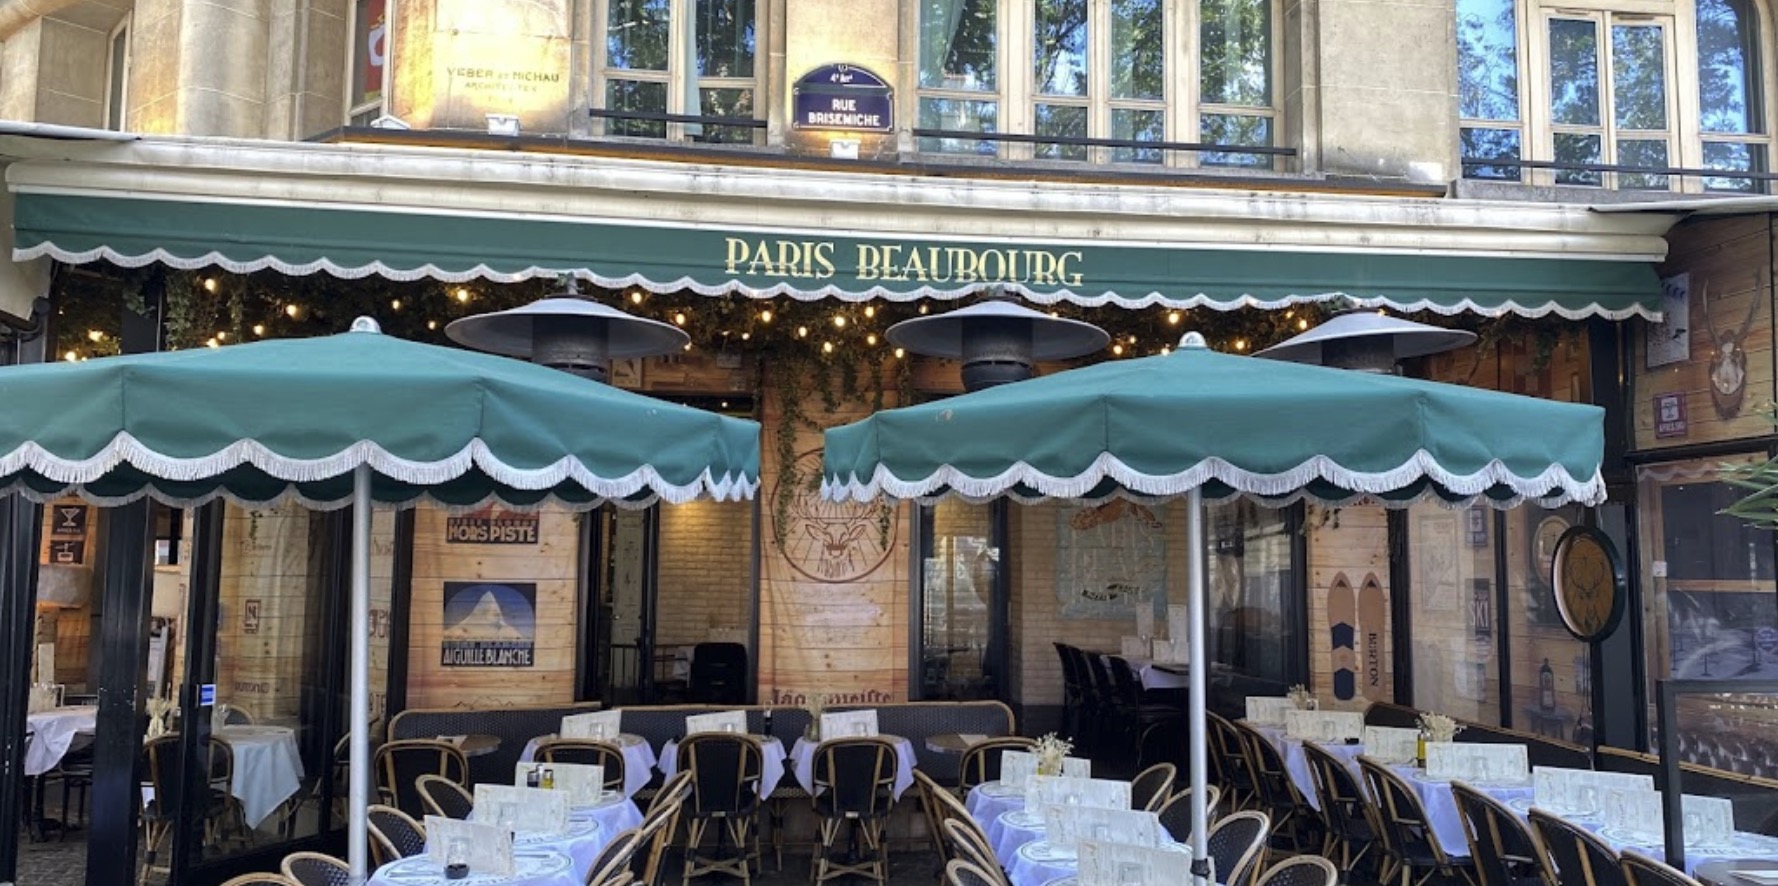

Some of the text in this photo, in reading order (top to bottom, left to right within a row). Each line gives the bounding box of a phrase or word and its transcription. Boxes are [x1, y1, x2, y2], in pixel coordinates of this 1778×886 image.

[512, 71, 560, 83] MICHAU
[464, 82, 538, 92] ARCHITETES
[832, 98, 857, 111] RUE
[808, 112, 880, 127] BRISEMICHE
[725, 237, 1084, 287] PARIS BEAUBOURG
[447, 525, 536, 542] HORS PISTE
[1467, 600, 1489, 629] SKI
[443, 648, 532, 665] AIGUILLE BLANCHE
[1368, 633, 1379, 687] BURTON
